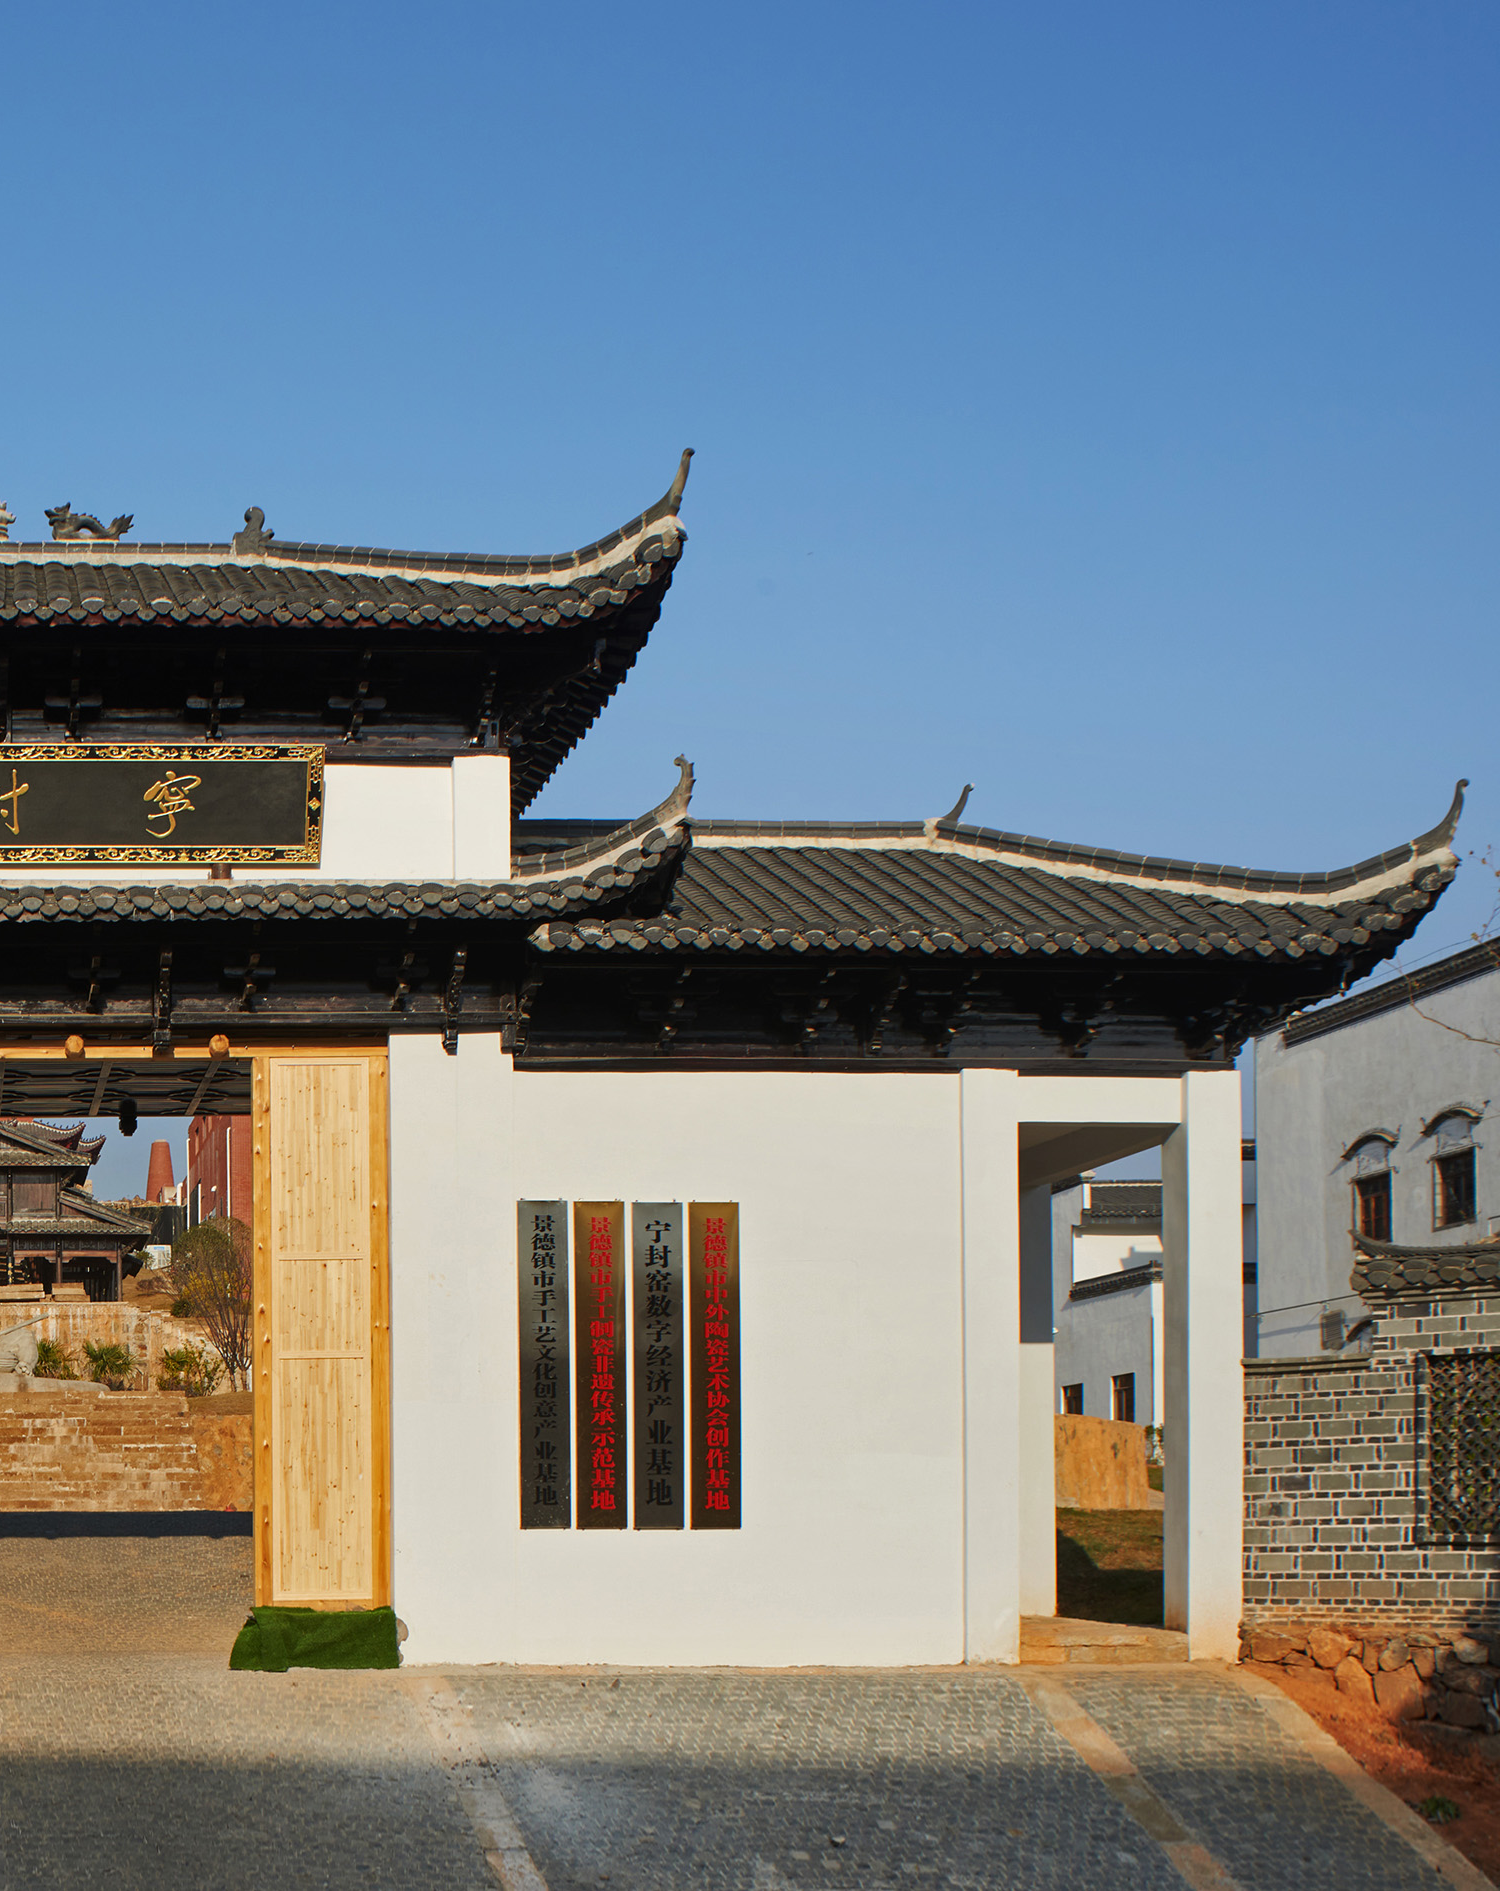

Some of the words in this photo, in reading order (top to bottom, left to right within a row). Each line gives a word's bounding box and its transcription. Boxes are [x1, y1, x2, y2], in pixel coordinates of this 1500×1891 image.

[530, 1214, 559, 1507] 景德镇市手工艺文化创意产业基地
[587, 1216, 617, 1511] 景德镇市手工制瓷非遗传承示范基地
[644, 1219, 673, 1507] 宁封窑数字经济产业基地
[701, 1216, 731, 1511] 景德镇市中外陶瓷艺术协会创作基地
